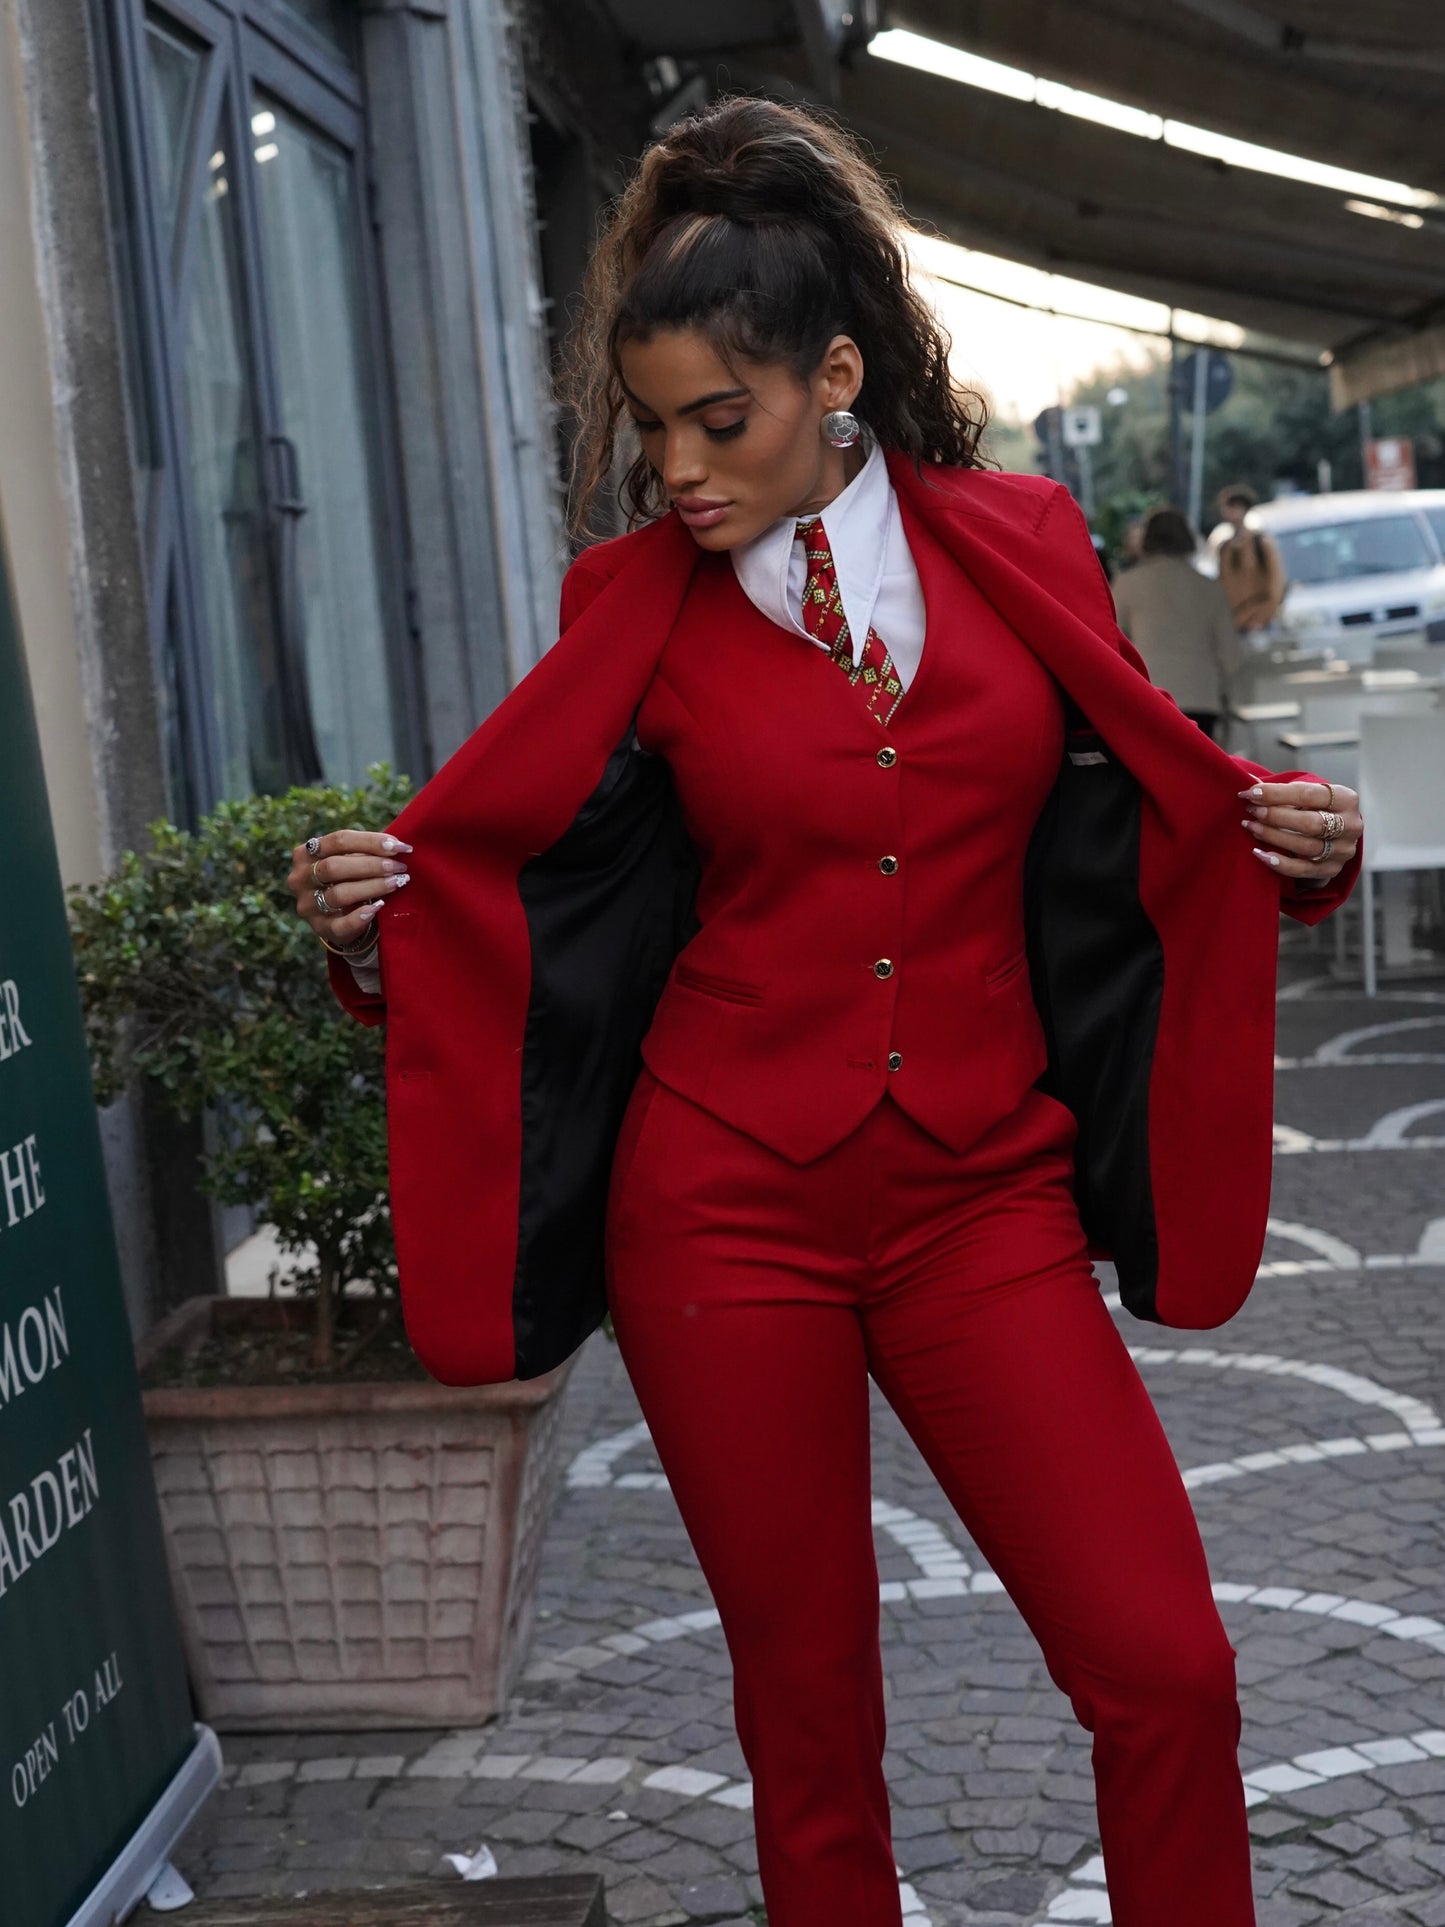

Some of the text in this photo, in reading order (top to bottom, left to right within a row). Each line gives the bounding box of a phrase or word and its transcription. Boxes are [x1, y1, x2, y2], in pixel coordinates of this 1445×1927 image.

[0, 1133, 46, 1232] HE
[0, 1285, 70, 1411] MON
[0, 1428, 99, 1598] ARDEN
[12, 1651, 124, 1808] OPEN TO ALL
